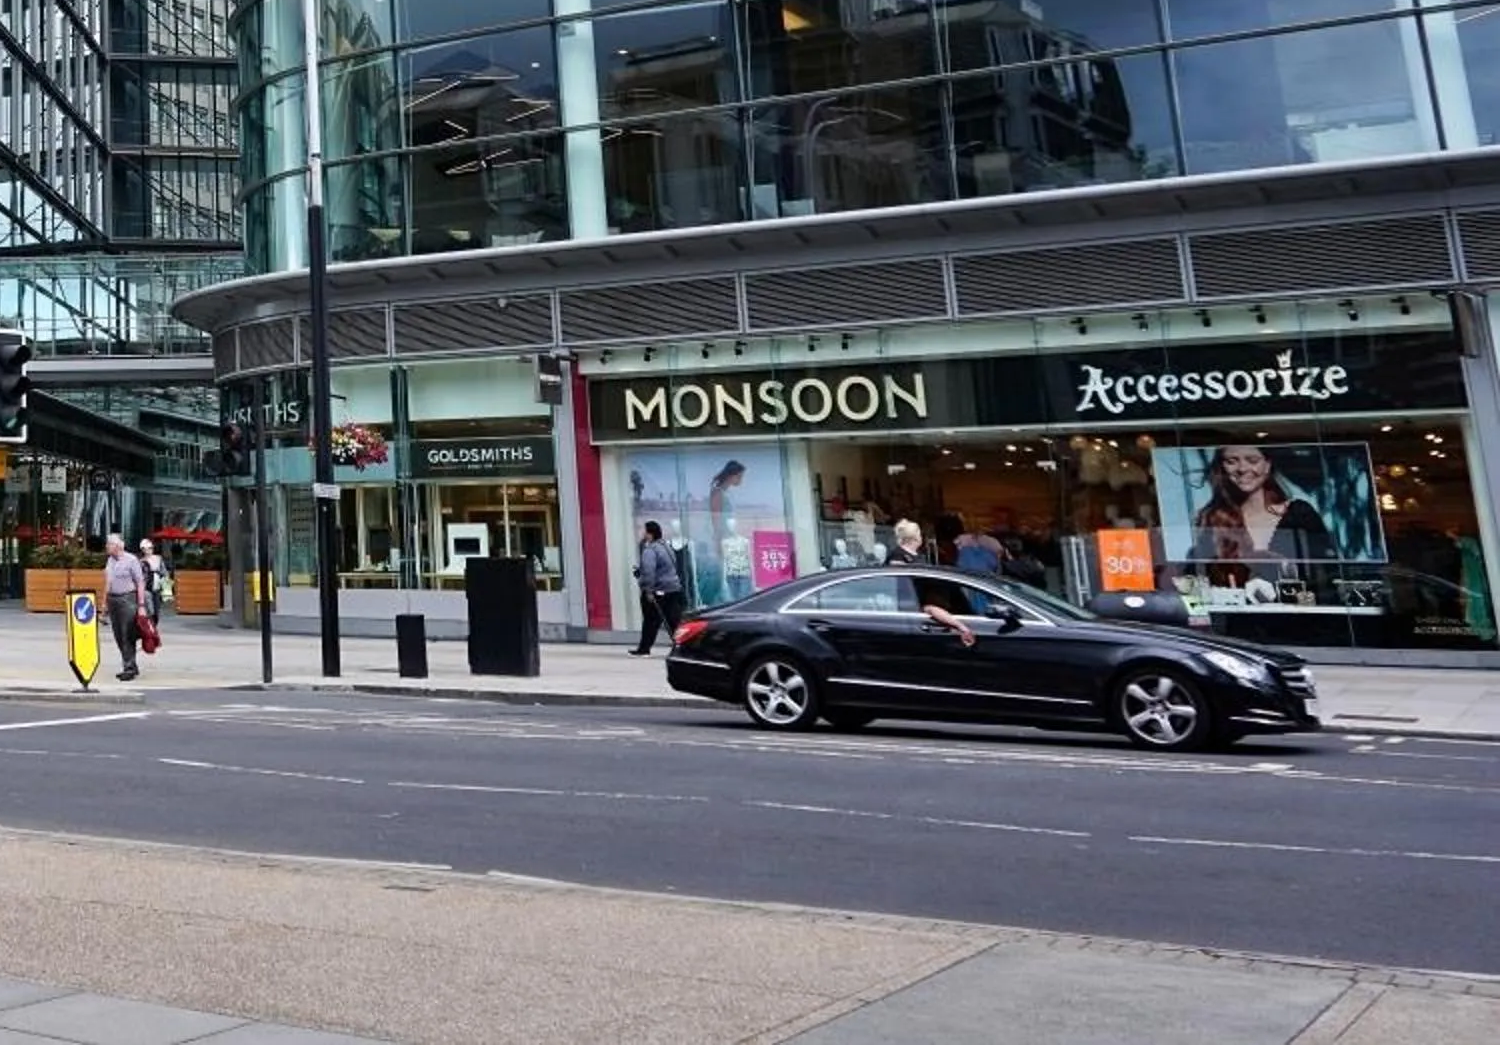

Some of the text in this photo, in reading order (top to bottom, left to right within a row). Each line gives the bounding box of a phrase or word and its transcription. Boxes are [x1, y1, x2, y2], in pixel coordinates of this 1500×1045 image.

[624, 372, 928, 430] MONSOON
[1075, 349, 1350, 414] Accessorize
[426, 445, 534, 464] GOLDSMITHS
